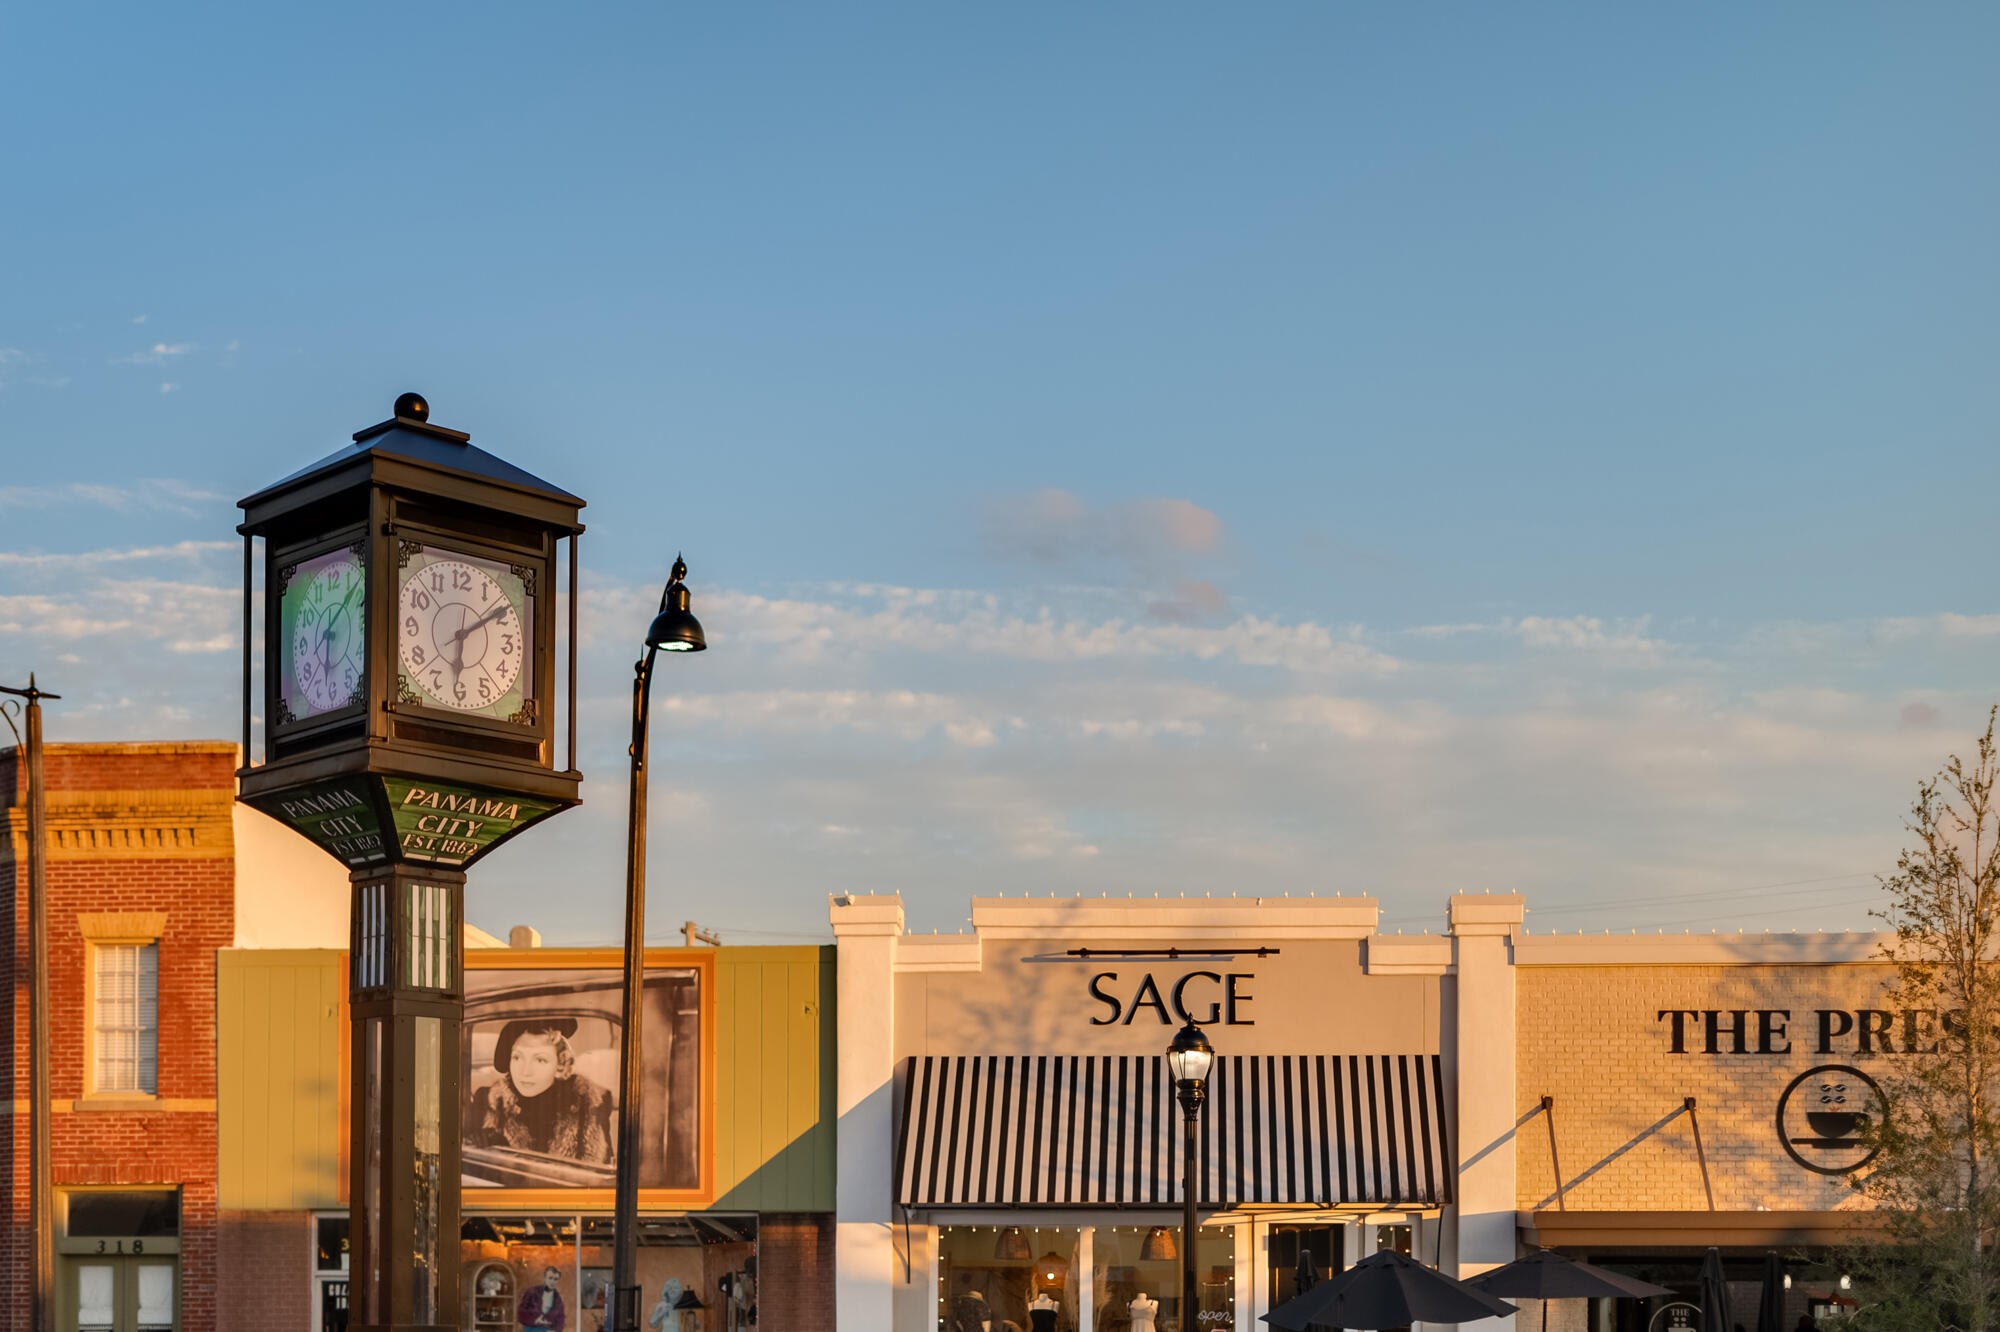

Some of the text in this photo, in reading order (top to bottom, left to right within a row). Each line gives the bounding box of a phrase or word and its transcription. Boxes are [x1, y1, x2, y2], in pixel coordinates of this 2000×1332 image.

[327, 569, 340, 592] 12
[430, 571, 445, 594] 11
[452, 568, 472, 592] 12
[481, 581, 489, 602] 1
[409, 588, 430, 611] 10
[405, 616, 420, 637] 9
[411, 645, 426, 666] 8
[501, 633, 514, 655] 3
[429, 669, 442, 690] 7
[496, 659, 509, 679] 4
[453, 680, 467, 701] 6
[478, 677, 491, 698] 5
[281, 789, 363, 818] PANAMA
[403, 787, 519, 820] PANAMA
[320, 814, 363, 837] CITY
[418, 815, 484, 838] CITY
[402, 833, 479, 857] EST. 1862
[1088, 971, 1255, 1026] SAGE
[1658, 1009, 2000, 1055] THE PRES
[96, 1239, 144, 1255] 318
[1198, 1310, 1232, 1325] open
